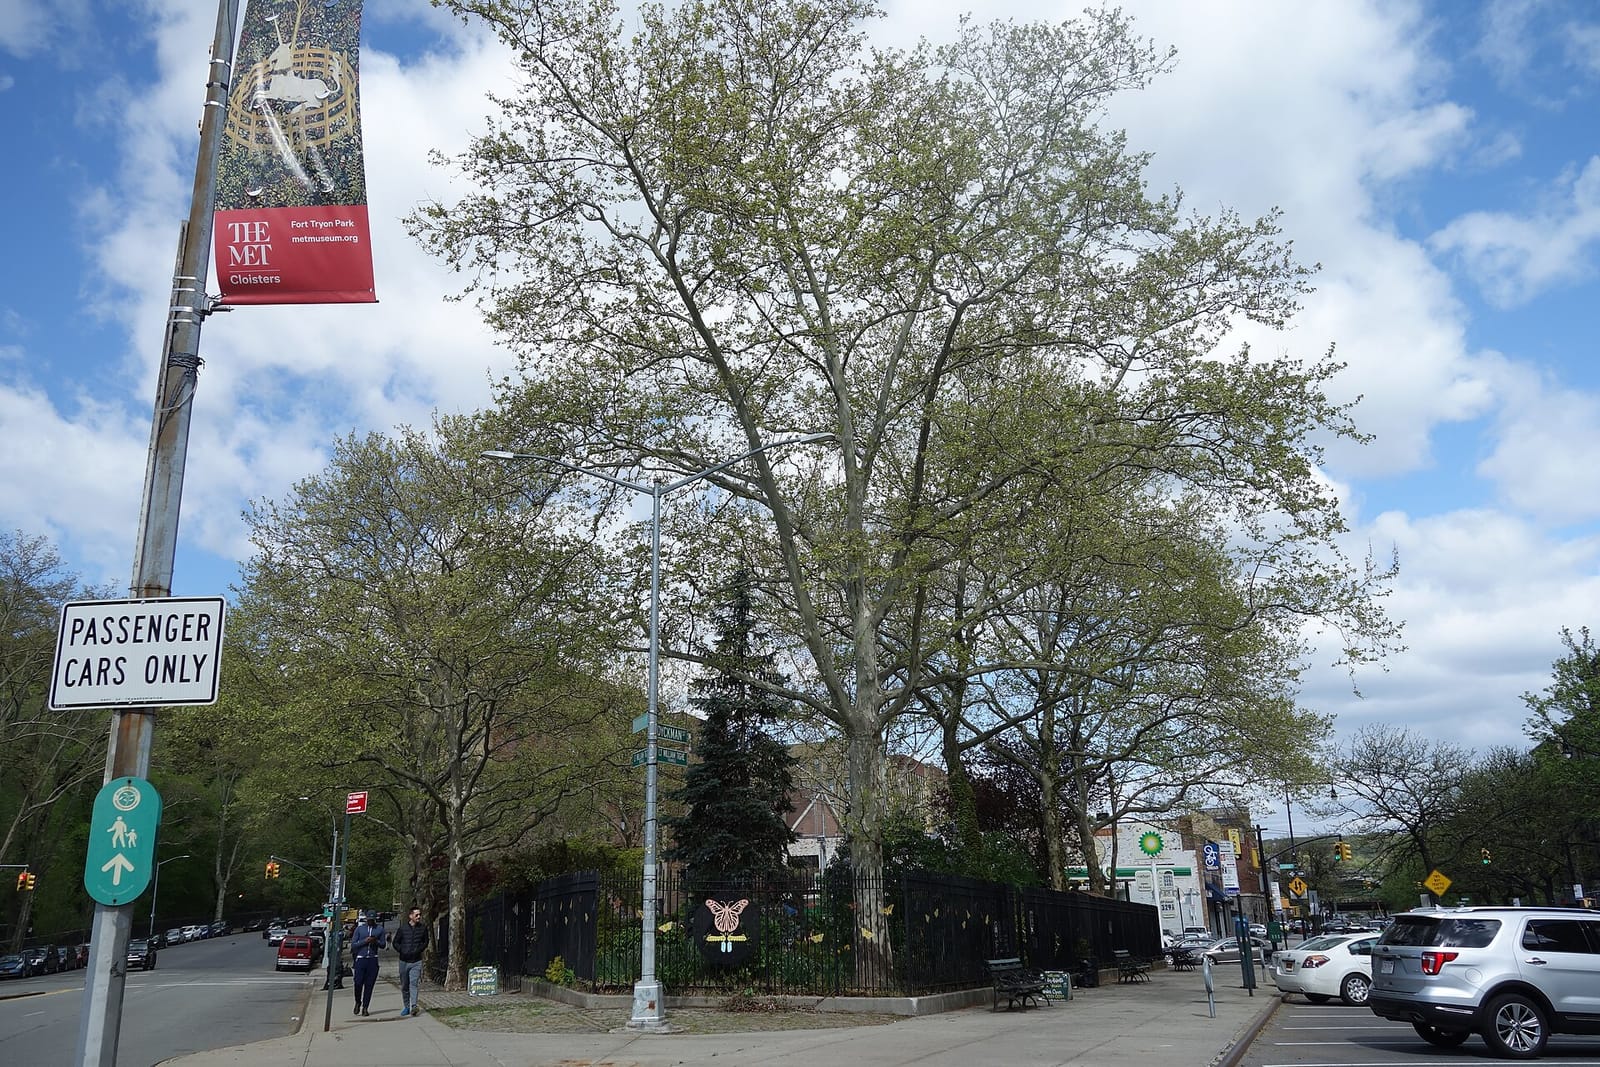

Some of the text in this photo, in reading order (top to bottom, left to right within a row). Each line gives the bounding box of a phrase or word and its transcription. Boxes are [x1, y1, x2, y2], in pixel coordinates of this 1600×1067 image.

[228, 221, 270, 243] THE
[291, 219, 354, 229] Fort Tryon Park
[292, 235, 358, 243] metmuseum.org
[228, 244, 272, 266] MET
[230, 274, 280, 285] Cloisters
[70, 613, 211, 646] PASSENGER
[65, 654, 208, 687] CARS ONLY
